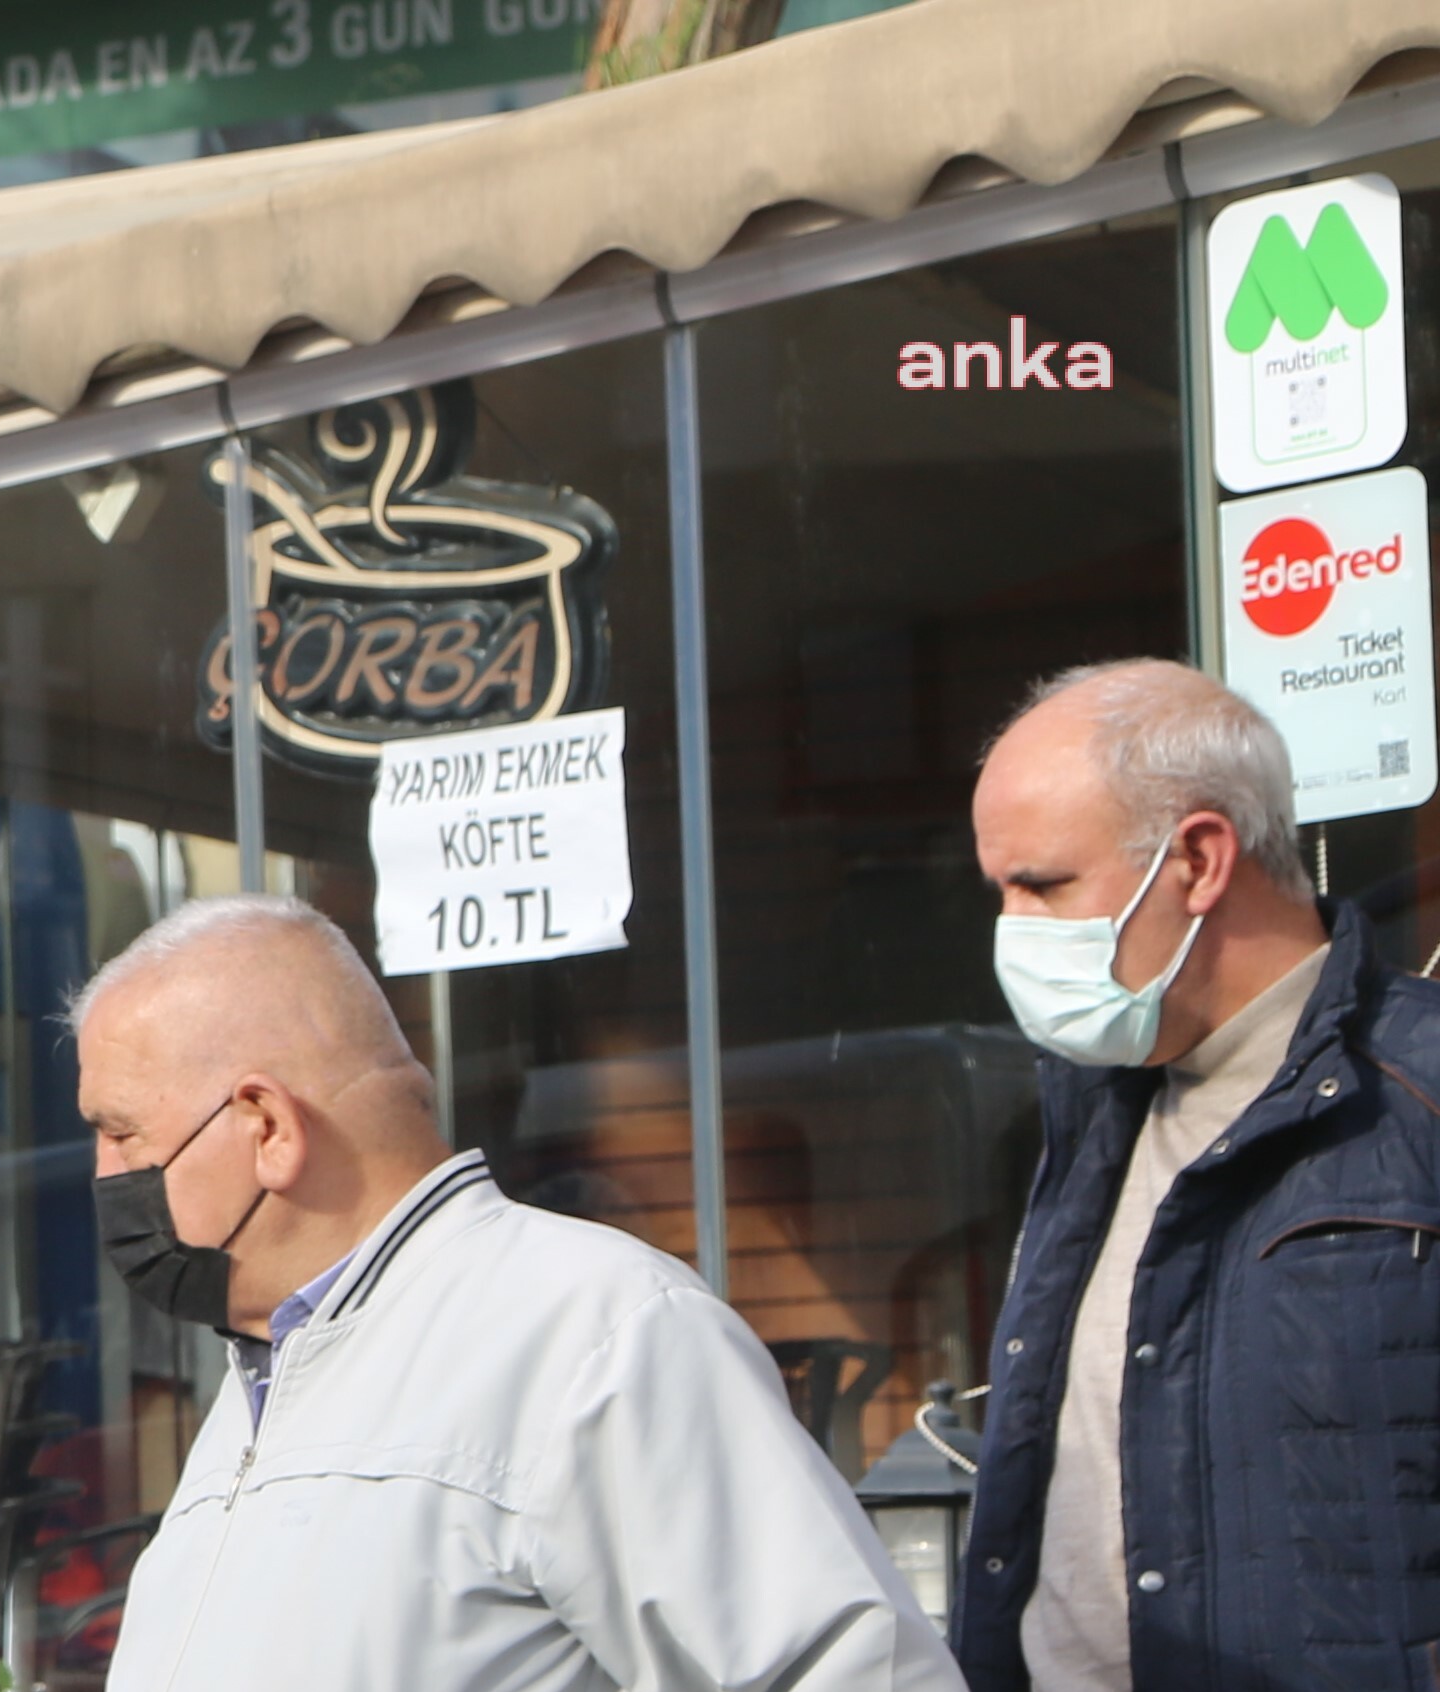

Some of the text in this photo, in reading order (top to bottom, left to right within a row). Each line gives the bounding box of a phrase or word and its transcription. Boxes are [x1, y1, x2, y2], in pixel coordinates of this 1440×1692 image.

[97, 33, 169, 95] EN
[185, 20, 257, 81] AZ
[270, 0, 313, 68] 3
[1265, 344, 1350, 376] multinet
[1241, 532, 1402, 604] Edenred
[207, 609, 539, 721] ÇORBA
[1281, 653, 1405, 693] Restaurant
[1338, 626, 1404, 658] Ticket
[390, 733, 608, 805] YARIM EKMEK
[439, 809, 550, 870] KÖFTE
[428, 887, 569, 952] 10.TL
